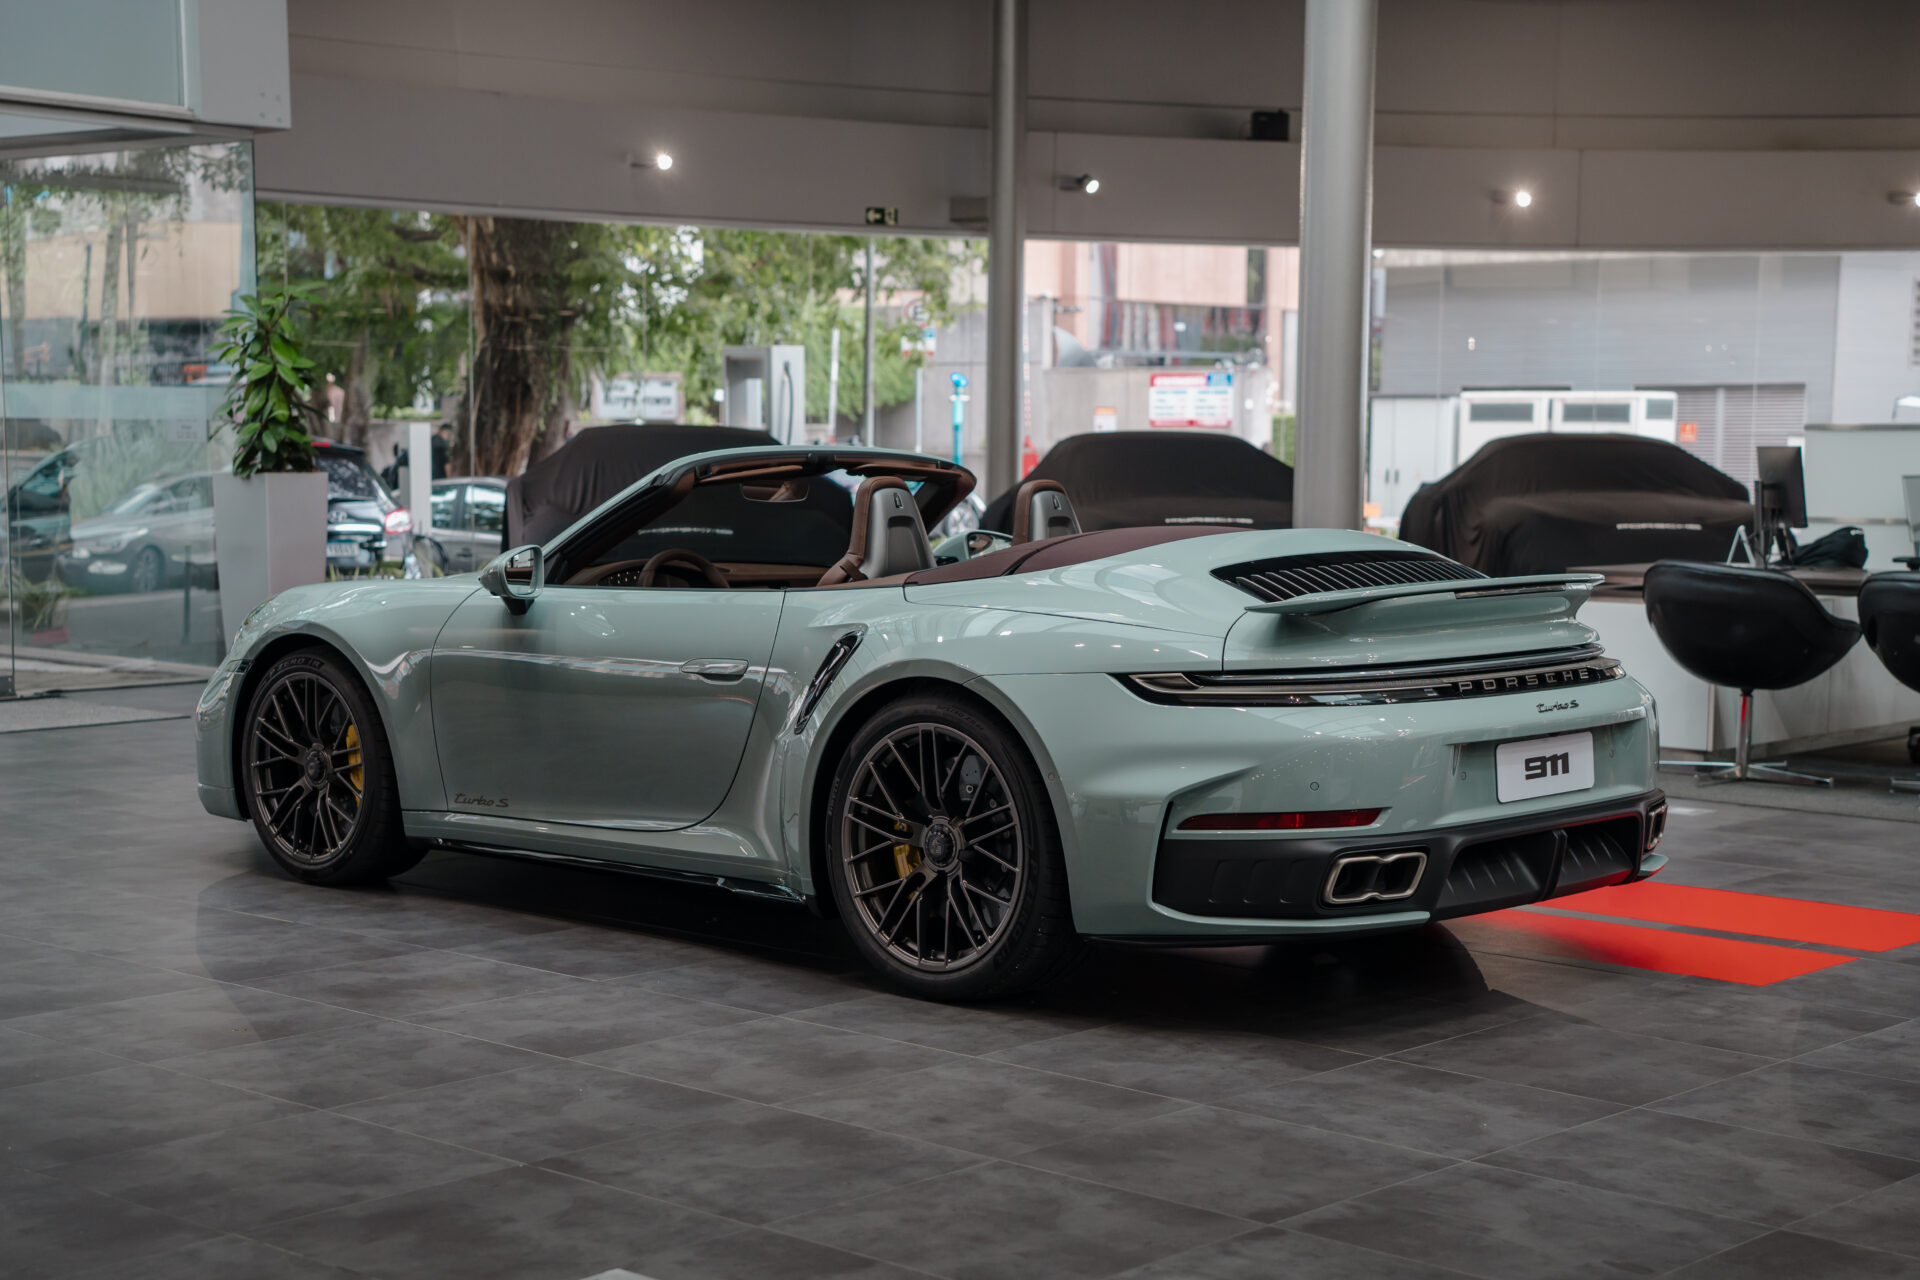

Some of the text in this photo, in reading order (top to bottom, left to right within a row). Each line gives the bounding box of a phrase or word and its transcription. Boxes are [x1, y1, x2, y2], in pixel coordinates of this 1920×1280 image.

[1458, 669, 1589, 692] PORSCHE
[1525, 752, 1569, 780] 911
[496, 798, 509, 807] S
